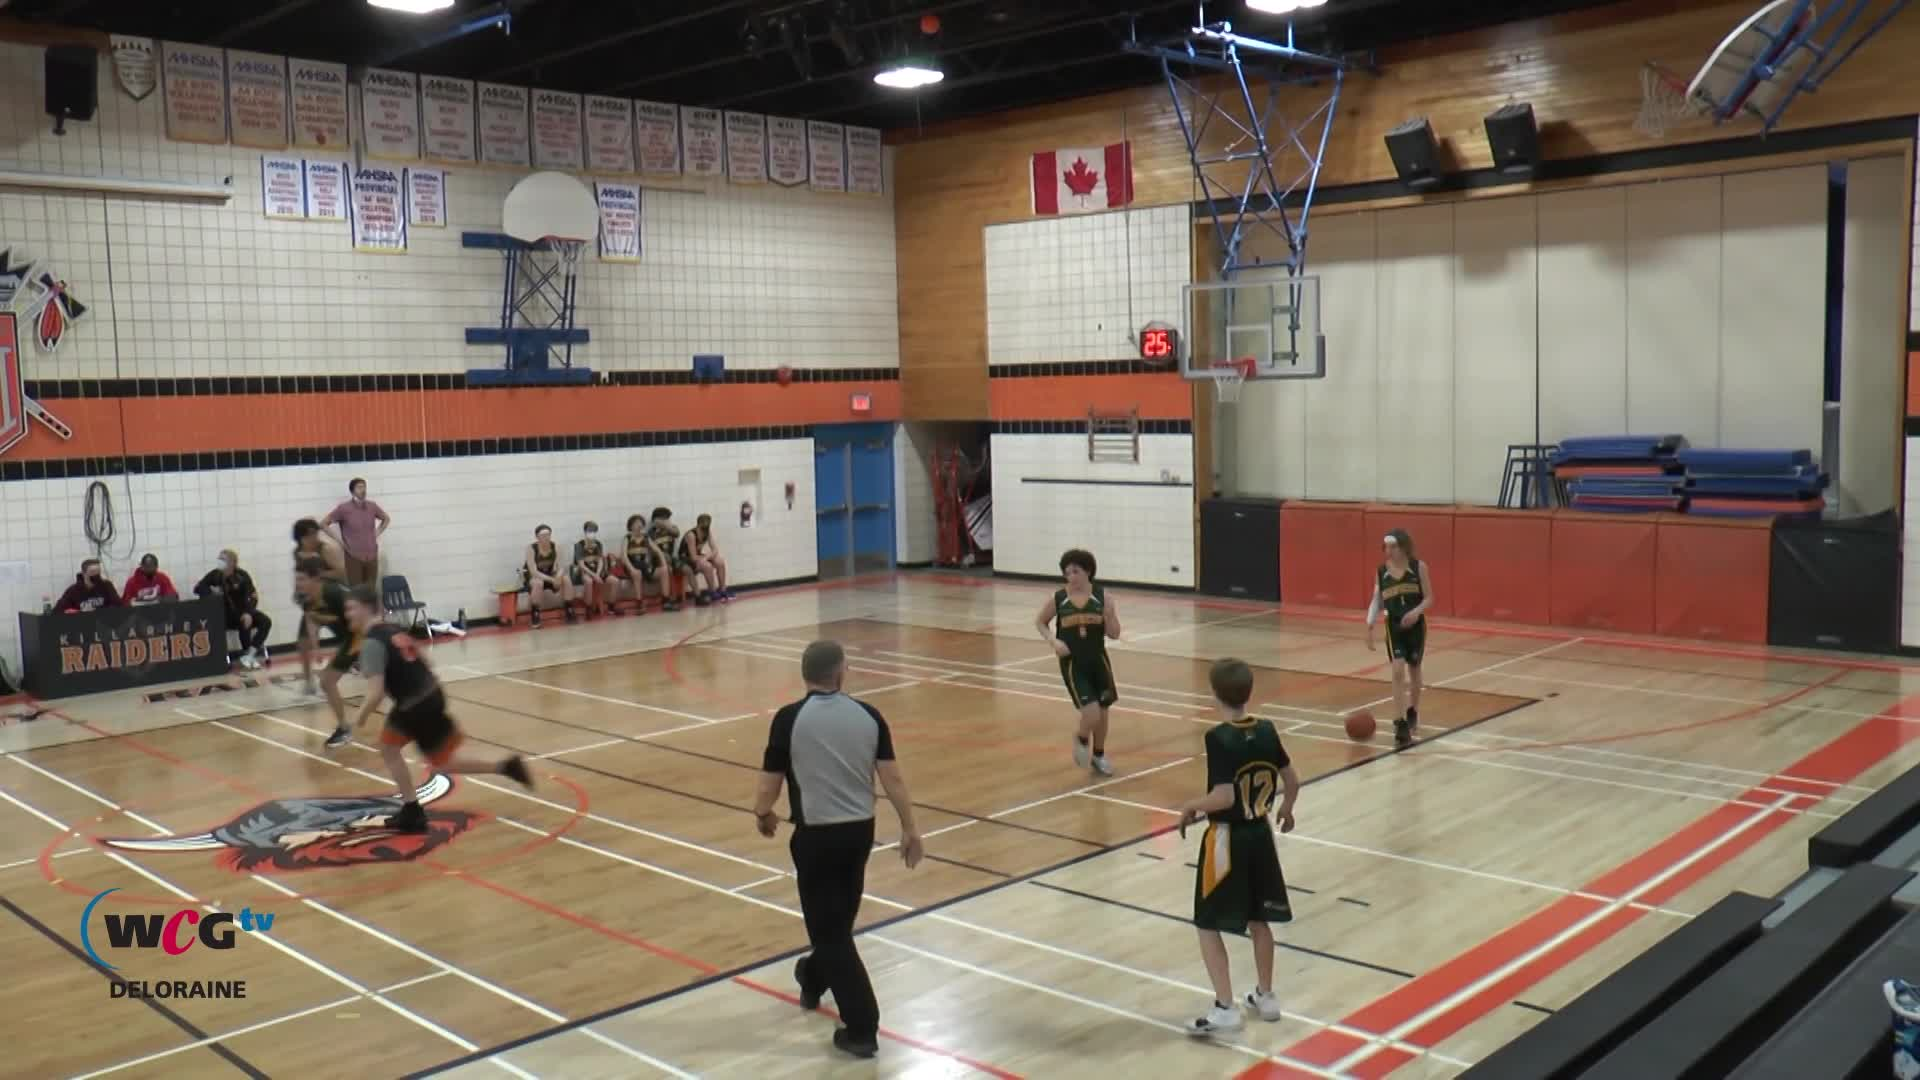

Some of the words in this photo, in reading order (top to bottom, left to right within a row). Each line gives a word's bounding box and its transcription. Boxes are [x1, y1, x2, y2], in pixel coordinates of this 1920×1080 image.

[1144, 332, 1168, 357] 25
[60, 618, 208, 646] KILLARNEY
[60, 630, 211, 675] RAIDERS
[1239, 767, 1274, 821] 12
